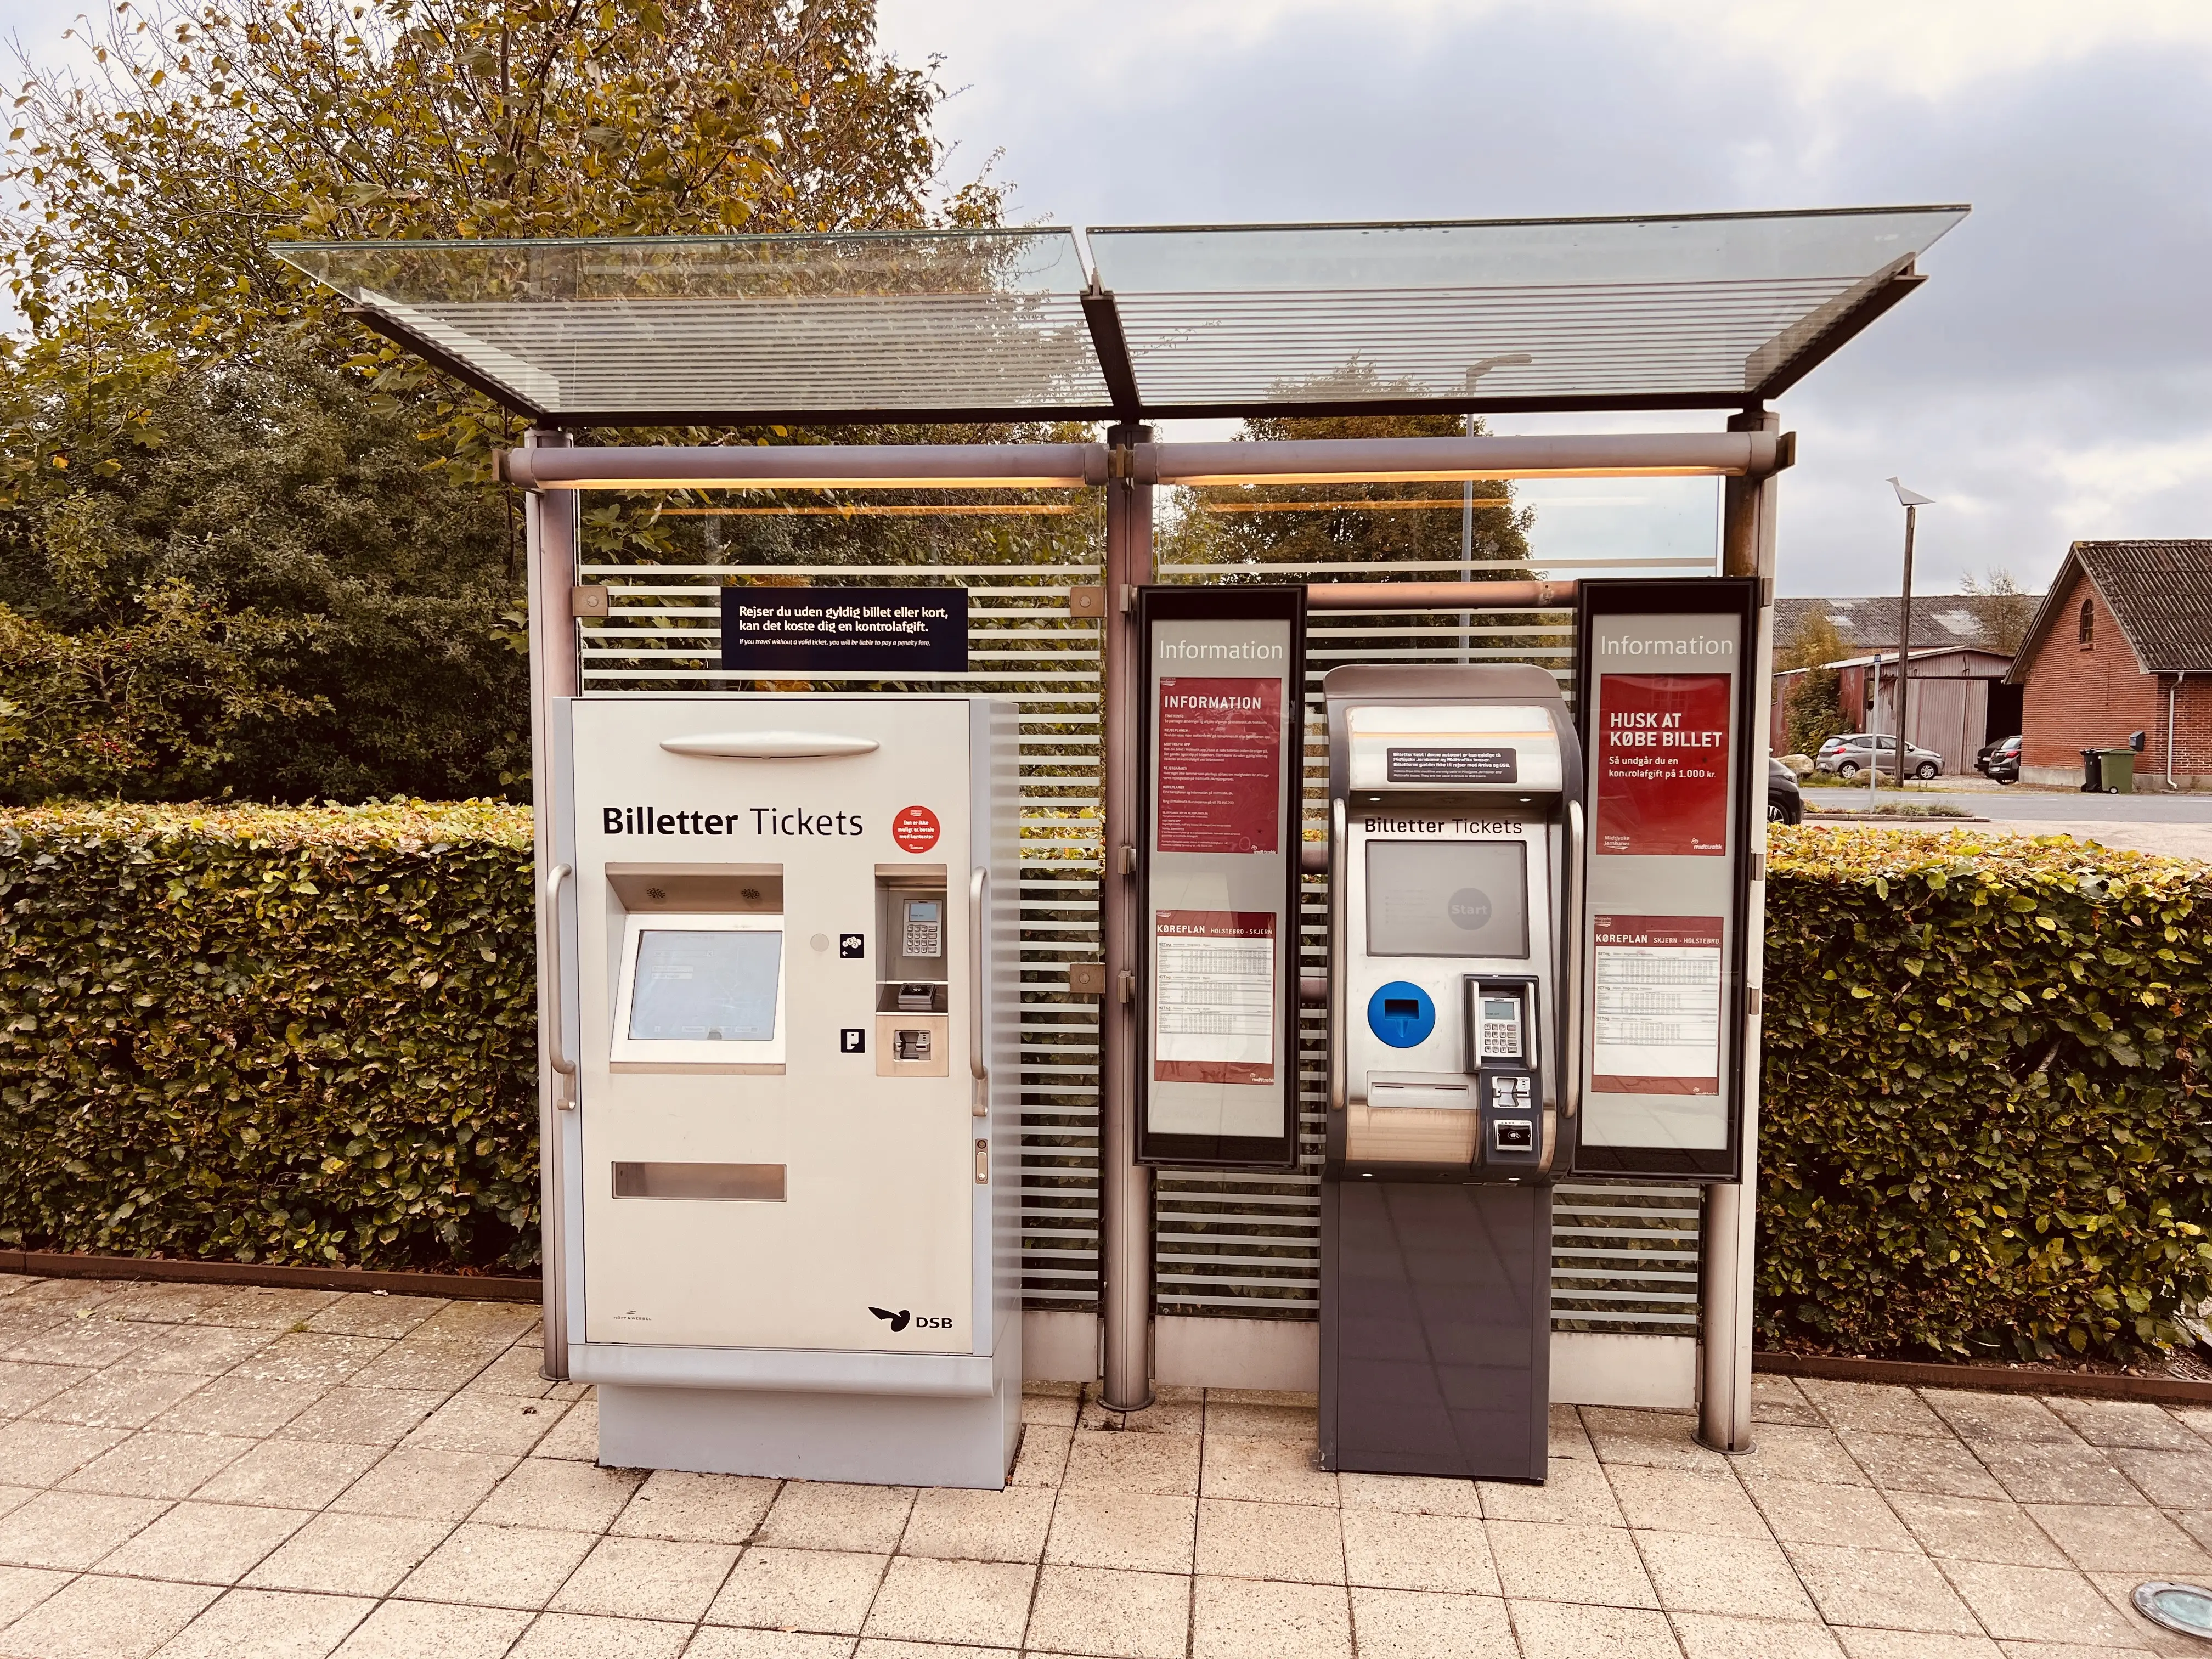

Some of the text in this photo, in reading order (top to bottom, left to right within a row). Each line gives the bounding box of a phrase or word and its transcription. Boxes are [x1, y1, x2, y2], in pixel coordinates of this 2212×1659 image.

[739, 606, 948, 619] Rejser du uden gyldig billet eller kort,
[739, 620, 929, 634] kan det koste dig en kontrolafgift.
[1160, 640, 1283, 659] Information
[1601, 635, 1733, 655] Information
[1165, 696, 1261, 709] INFORMATION
[1611, 713, 1681, 727] HUSK AT
[1610, 731, 1722, 747] KØBE BILLET
[1622, 757, 1653, 766] undgår
[1665, 770, 1676, 779] på
[1679, 770, 1705, 778] 1.000
[603, 806, 863, 836] Billetter Tickets
[1365, 817, 1522, 834] Billetter Tickets
[1451, 905, 1488, 915] Start
[1157, 924, 1205, 933] KØREPLAN
[1595, 934, 1648, 943] KØREPLAN
[916, 1317, 953, 1329] DSB
